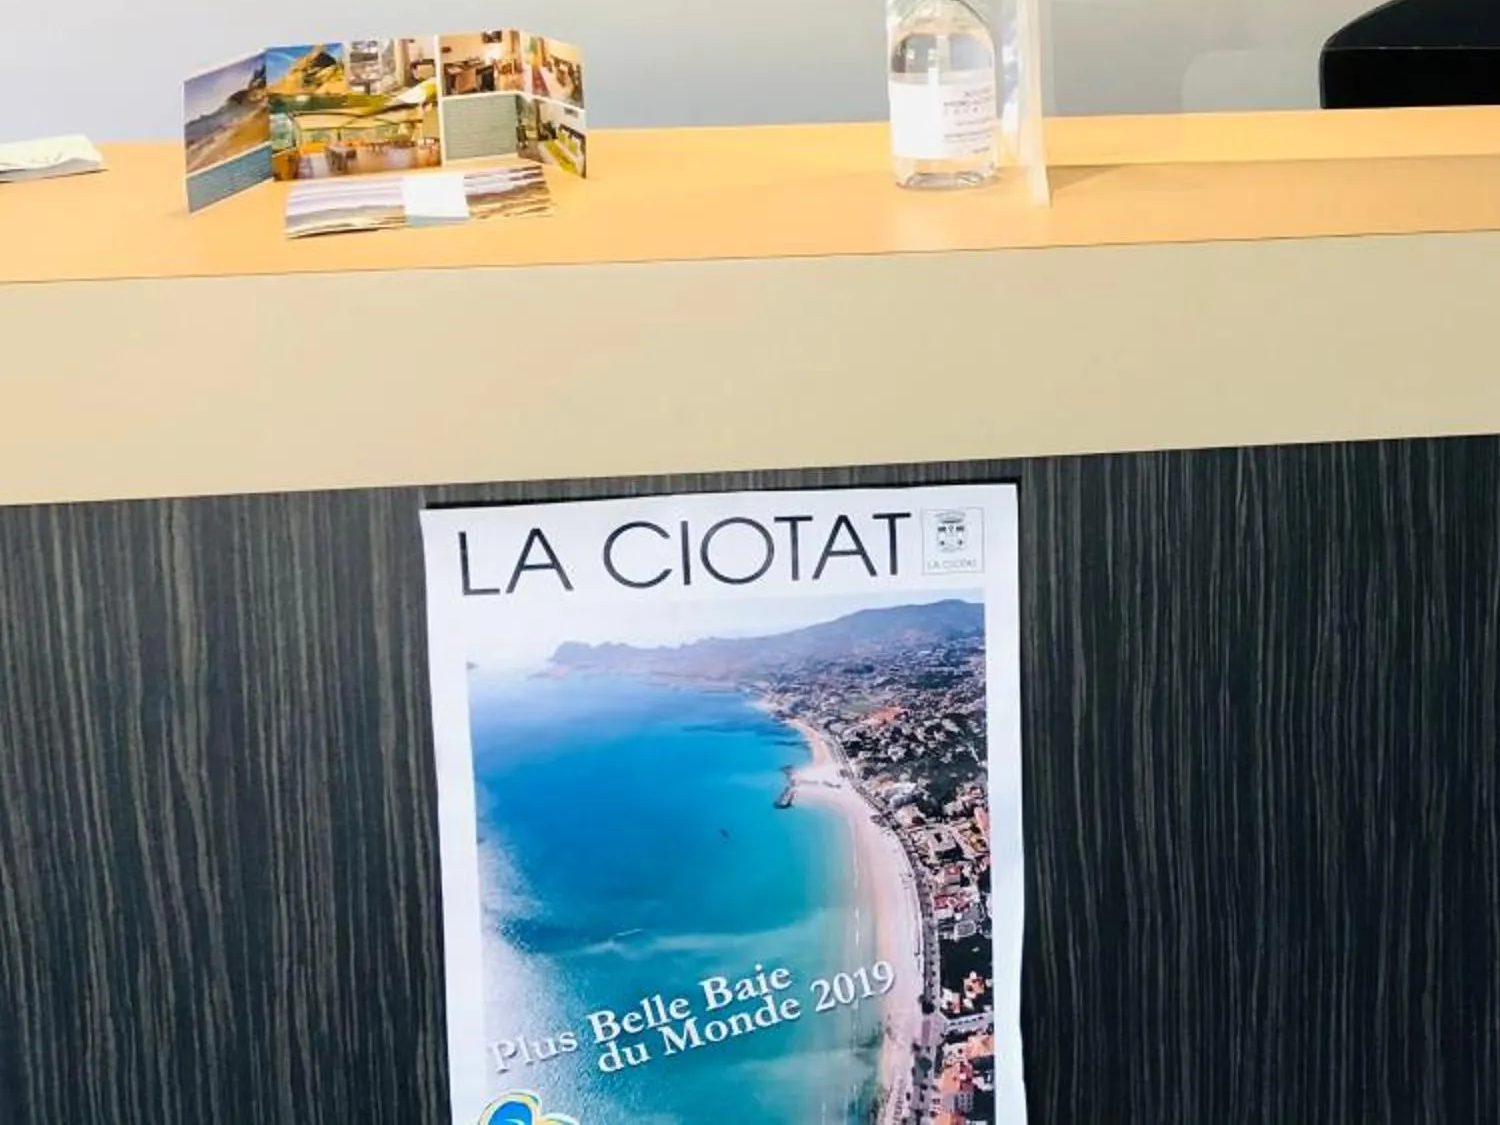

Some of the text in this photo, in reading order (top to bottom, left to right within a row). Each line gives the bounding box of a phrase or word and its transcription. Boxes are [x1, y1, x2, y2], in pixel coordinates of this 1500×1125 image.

[458, 511, 912, 596] LA CIOTAT
[489, 962, 793, 1074] Plus Belle Baie
[596, 958, 897, 1074] du Monde 2019
